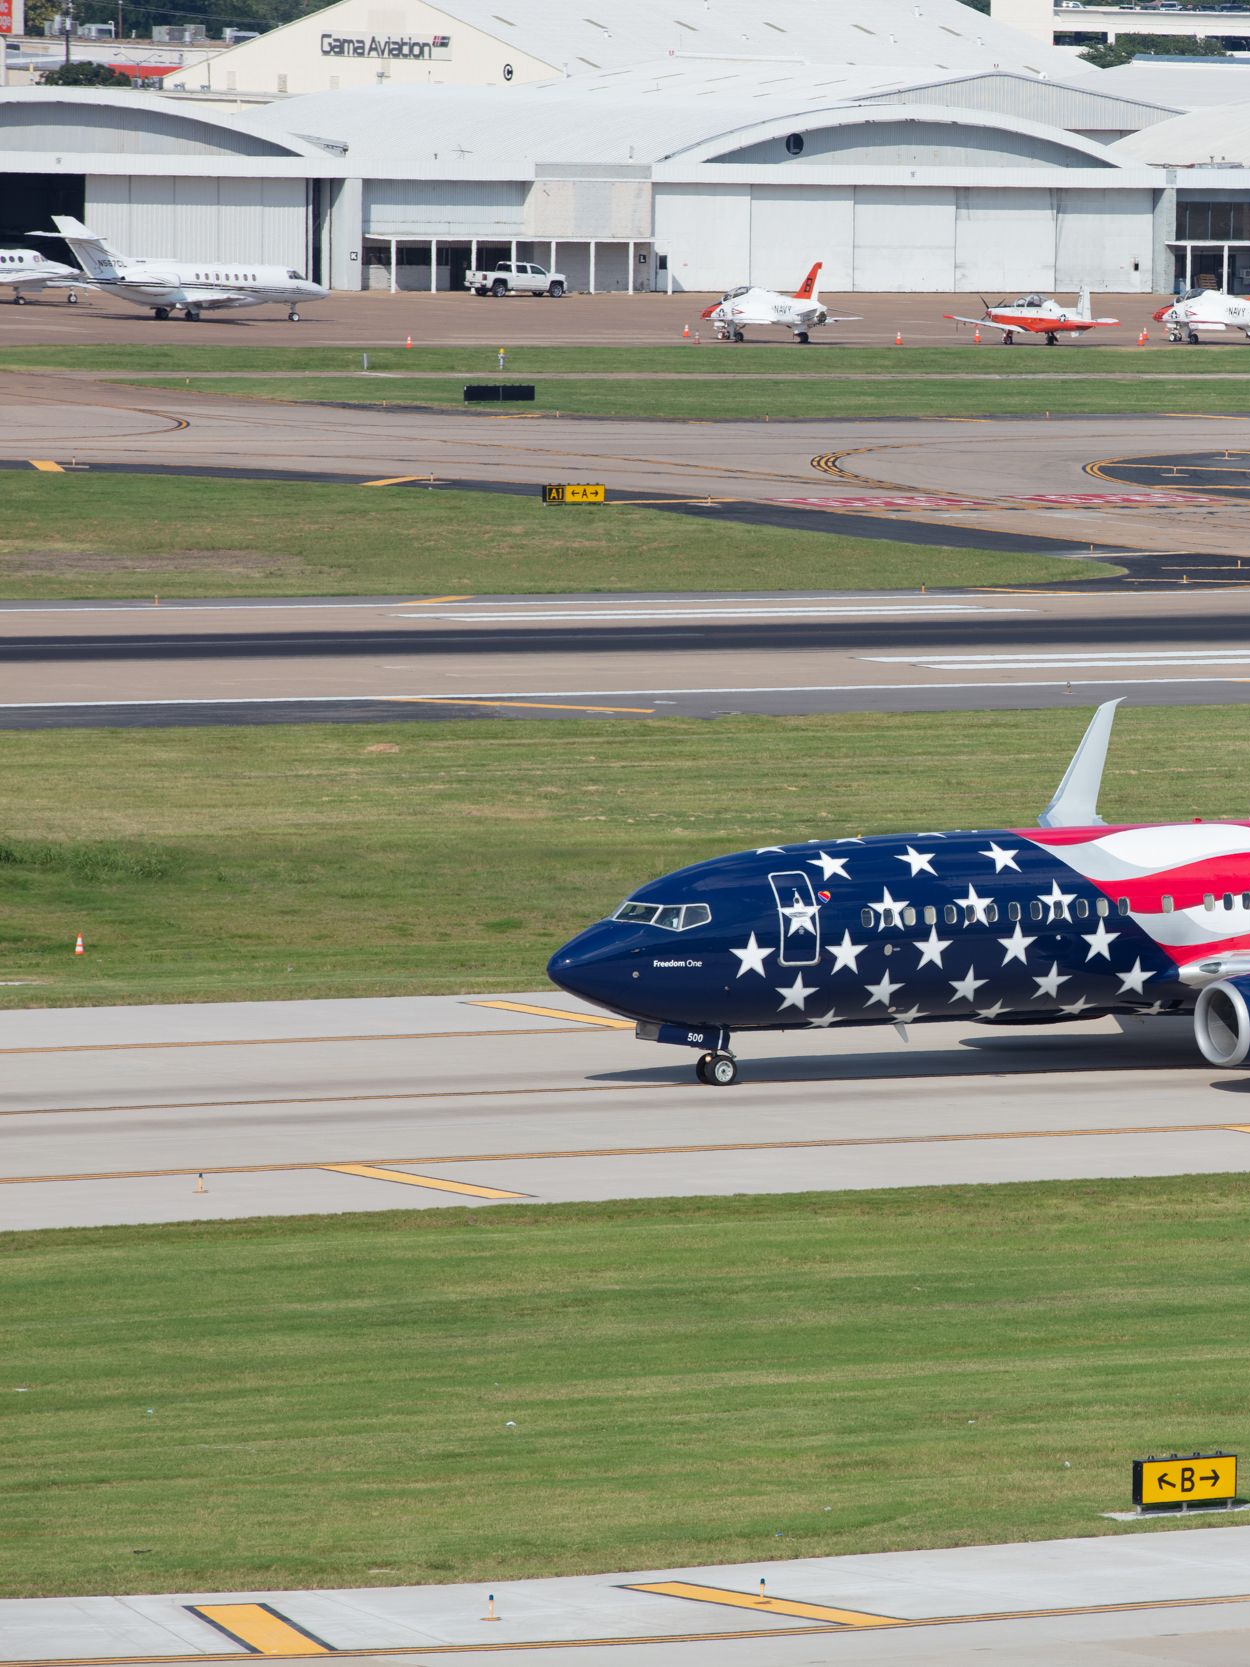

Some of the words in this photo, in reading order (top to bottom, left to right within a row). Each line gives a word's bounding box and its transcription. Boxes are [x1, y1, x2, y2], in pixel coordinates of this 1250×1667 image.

[321, 33, 365, 57] Gama
[367, 36, 432, 59] Aviation
[504, 65, 512, 80] C
[804, 278, 813, 292] B
[774, 305, 792, 315] NAVY
[1228, 306, 1246, 317] NAVY
[550, 488, 563, 499] A1
[581, 488, 589, 499] A
[653, 959, 686, 968] Freedom
[686, 959, 703, 968] One
[687, 1032, 704, 1043] 500
[1181, 1467, 1196, 1493] B
